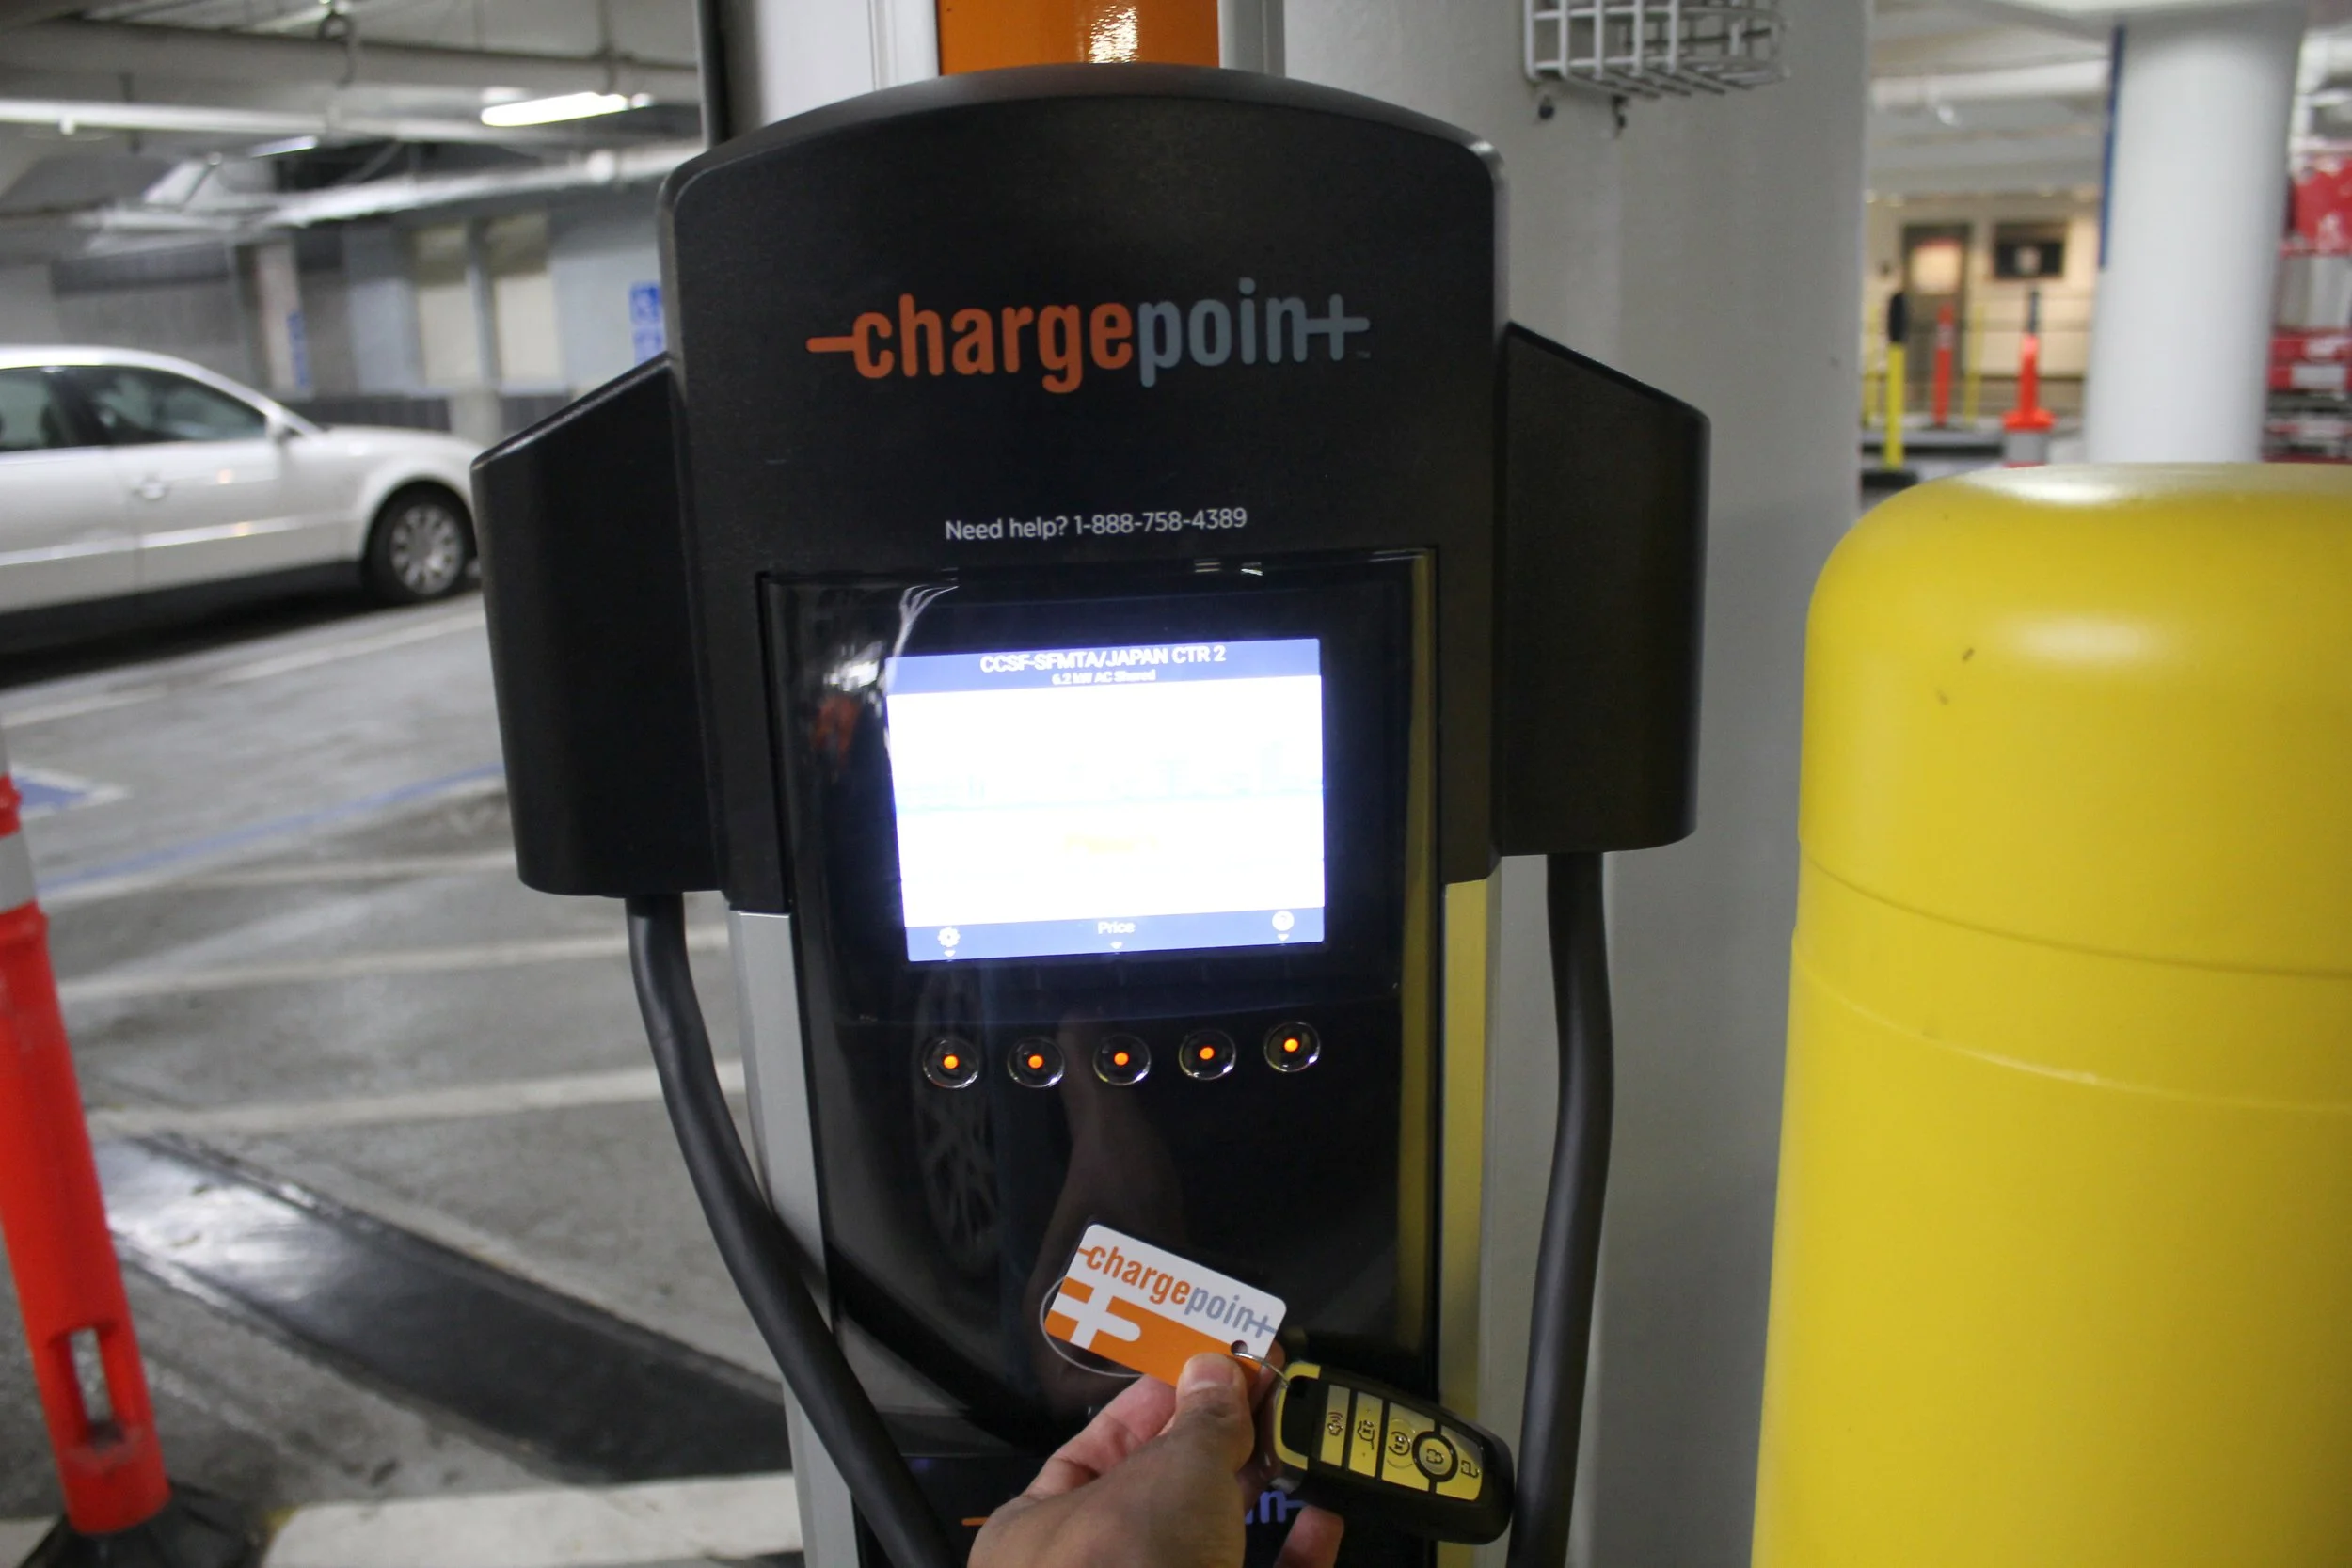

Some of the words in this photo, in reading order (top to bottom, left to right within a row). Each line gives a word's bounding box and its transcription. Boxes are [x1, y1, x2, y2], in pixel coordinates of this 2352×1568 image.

[806, 277, 1371, 393] chargepoint
[945, 519, 1003, 540] Need
[1009, 515, 1068, 540] help?
[1073, 507, 1248, 534] 1-888-758-4389
[979, 647, 1169, 673] CCSF-SFMTA/JAPAN
[1171, 645, 1212, 664] CTR
[1213, 644, 1227, 662] 2
[1052, 672, 1073, 686] 6.2
[1094, 671, 1111, 684] AC
[1097, 921, 1136, 935] Price
[1079, 1245, 1277, 1339] chargepoint
